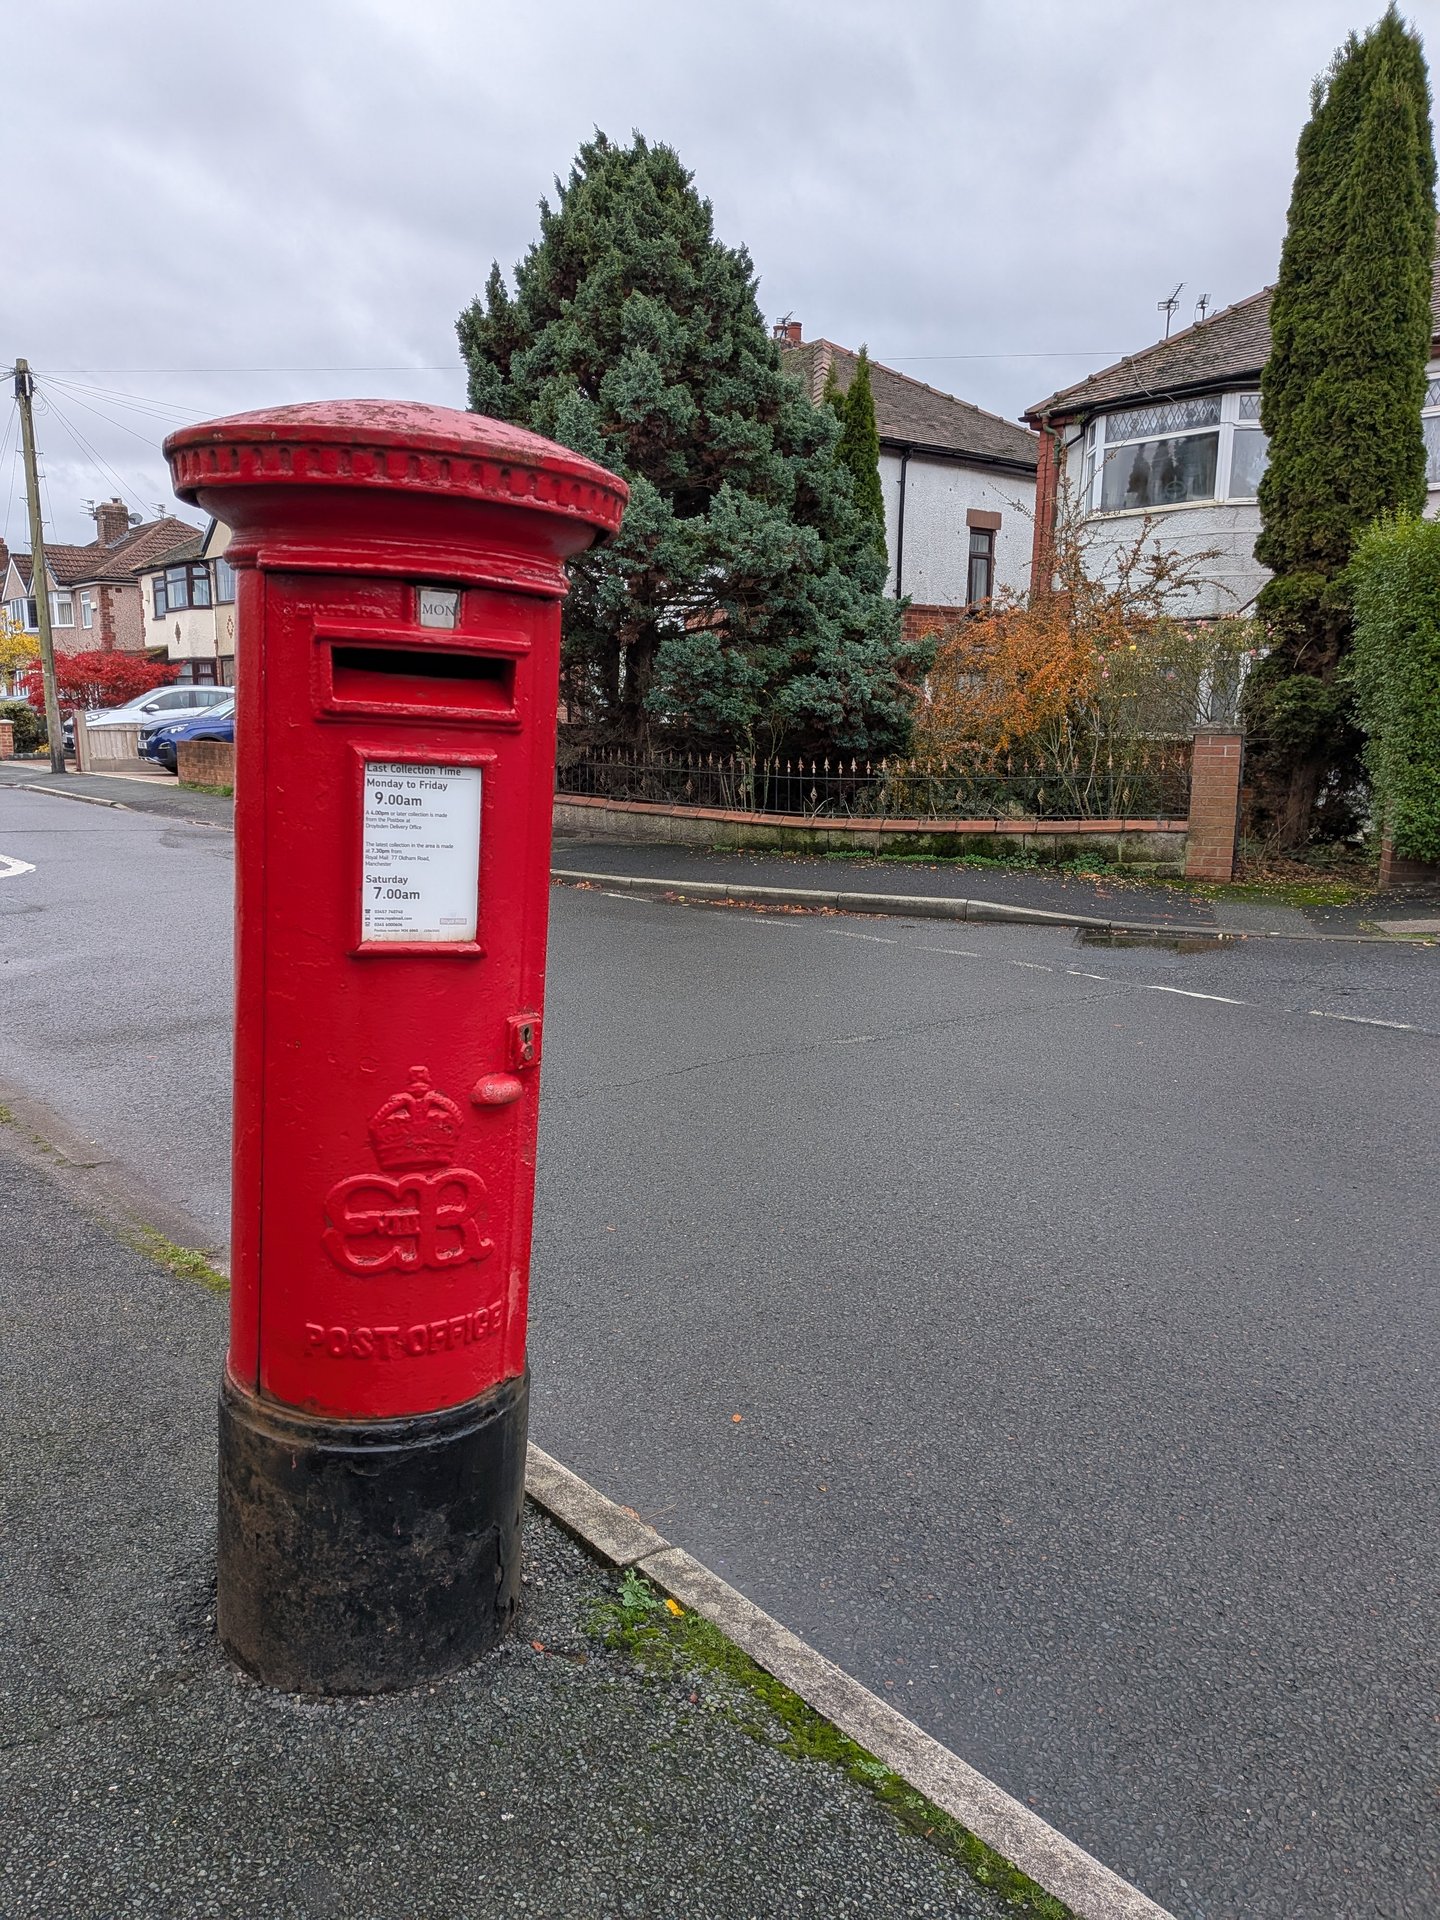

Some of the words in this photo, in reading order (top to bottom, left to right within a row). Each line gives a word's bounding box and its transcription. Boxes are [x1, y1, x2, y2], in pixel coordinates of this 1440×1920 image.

[422, 603, 454, 616] MON
[367, 763, 387, 772] Last
[390, 764, 436, 774] Collection
[438, 766, 461, 776] Time
[366, 778, 404, 790] Monday
[420, 780, 448, 792] Friday
[374, 791, 422, 806] 9.00am
[366, 874, 408, 885] Saturday
[374, 886, 420, 900] 7.00am
[304, 1322, 400, 1360] POST
[405, 1299, 503, 1357] OFFICE
